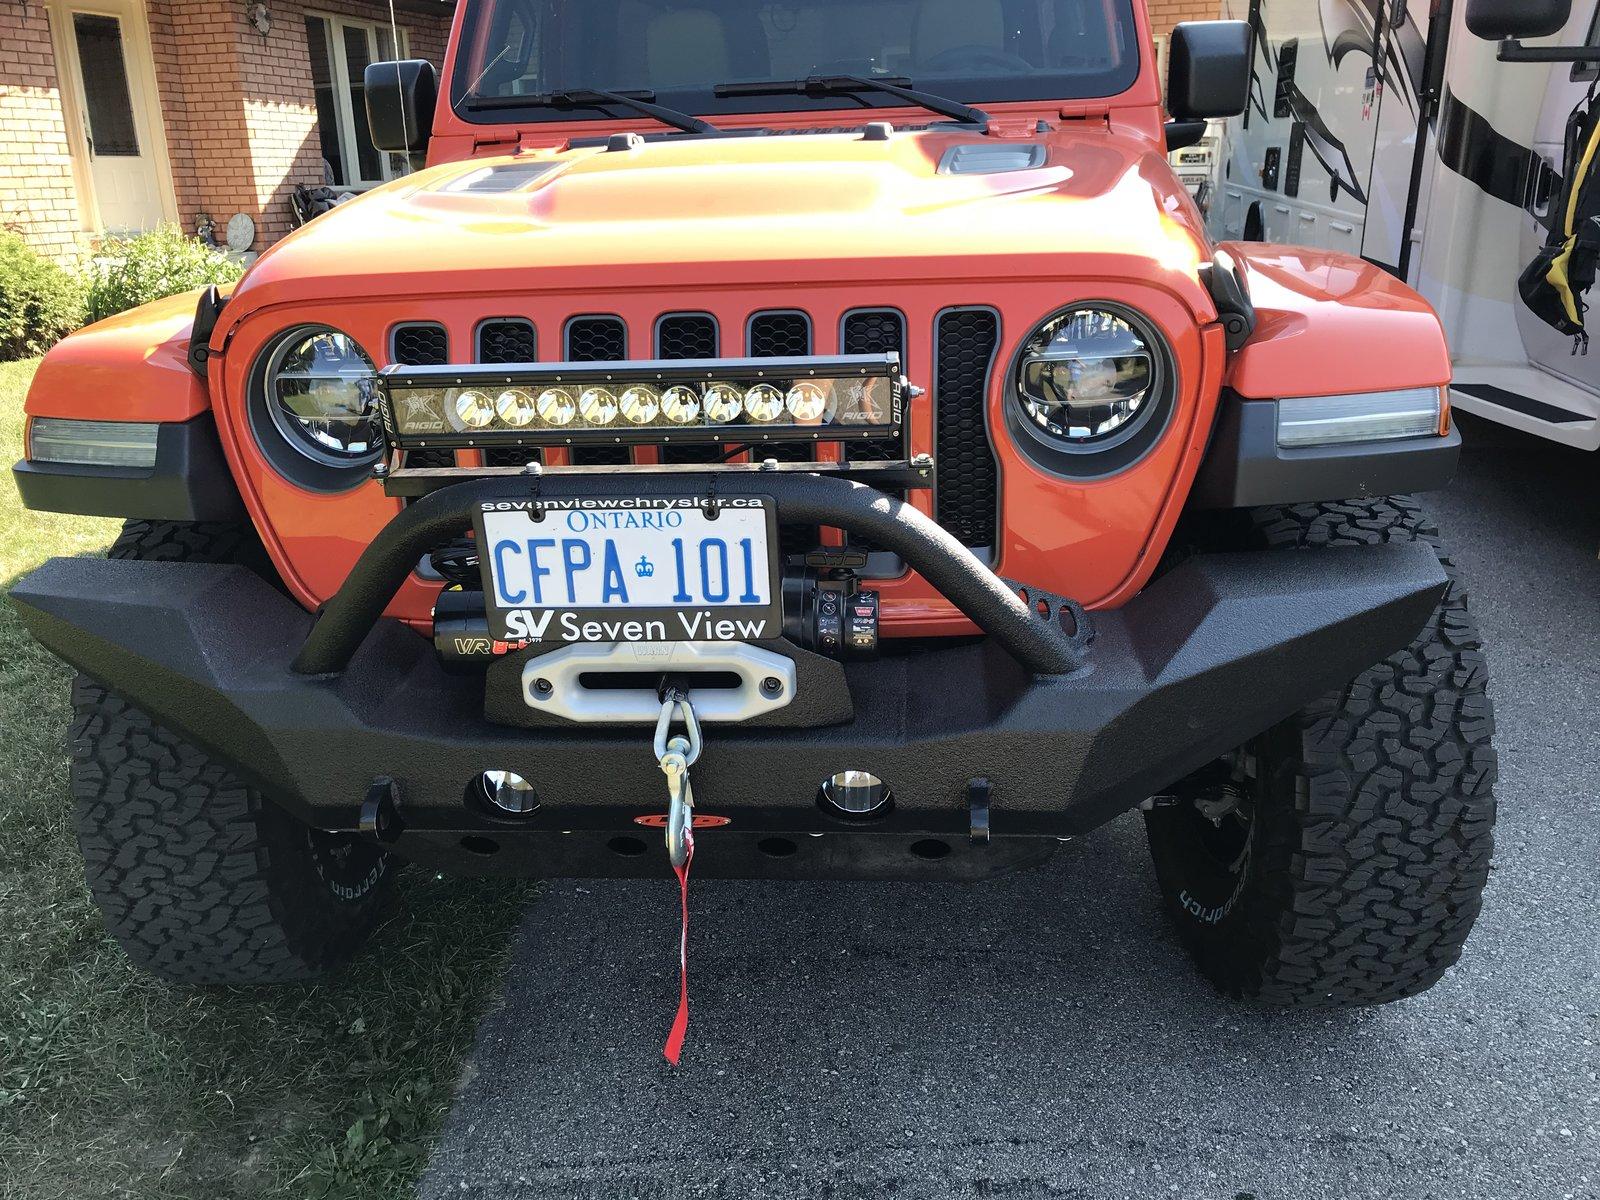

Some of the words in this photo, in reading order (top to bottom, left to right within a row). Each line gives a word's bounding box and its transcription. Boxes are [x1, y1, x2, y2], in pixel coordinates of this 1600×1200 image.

[378, 391, 394, 434] RIGID
[842, 411, 883, 420] RIGID
[893, 381, 902, 424] RIGID
[403, 421, 444, 430] RIGID
[481, 496, 763, 511] sevenviewchrysler.ca
[494, 538, 629, 604] CFPA
[672, 537, 760, 603] 101
[504, 610, 554, 639] SV
[560, 612, 665, 641] Seven
[677, 611, 767, 640] View
